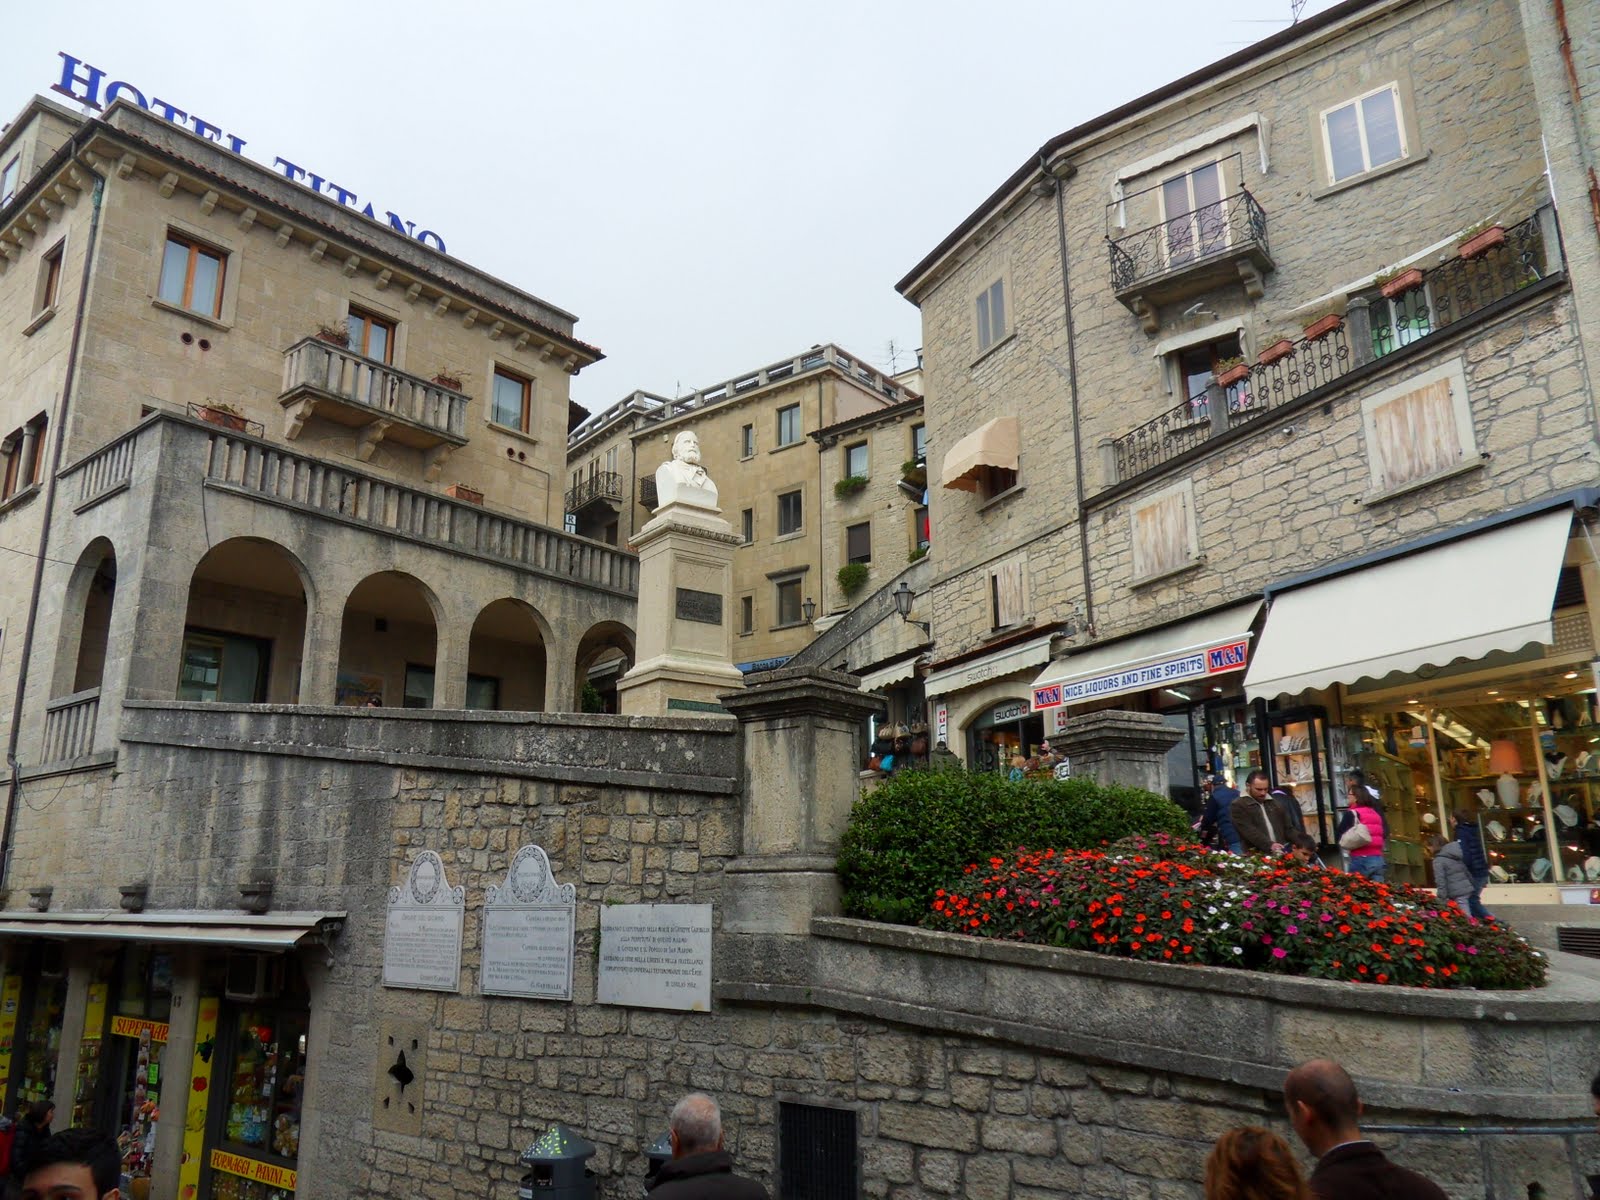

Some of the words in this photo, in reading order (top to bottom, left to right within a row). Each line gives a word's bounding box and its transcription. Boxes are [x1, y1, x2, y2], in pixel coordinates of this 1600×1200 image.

[1209, 645, 1245, 668] M&N
[967, 665, 993, 682] swatch
[1065, 684, 1083, 699] NICE
[1085, 677, 1119, 693] LIQUORS
[1122, 673, 1139, 686] AND
[1141, 667, 1162, 682] FINE
[1165, 657, 1203, 677] SPIRITS
[1036, 688, 1060, 705] M&N
[995, 706, 1021, 721] swatch
[212, 1152, 250, 1175] FORMAGGI
[255, 1164, 283, 1184] PANINI
